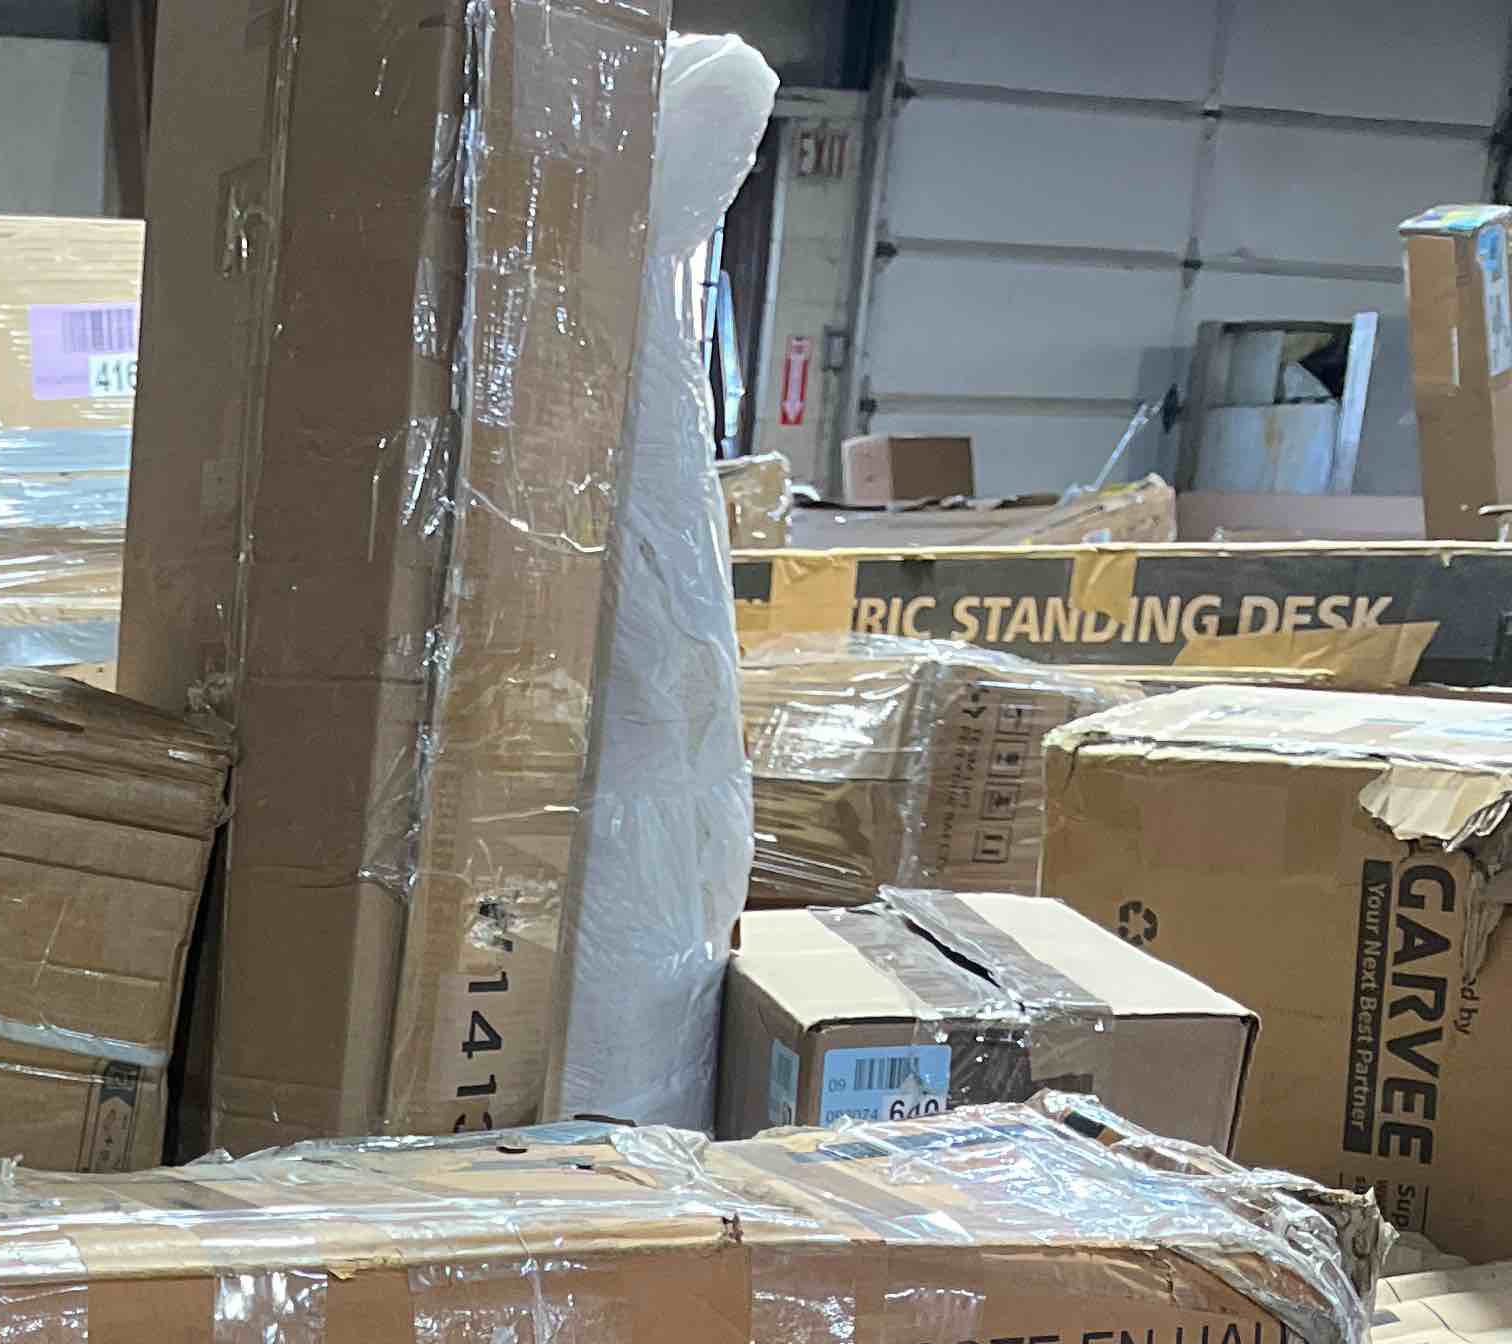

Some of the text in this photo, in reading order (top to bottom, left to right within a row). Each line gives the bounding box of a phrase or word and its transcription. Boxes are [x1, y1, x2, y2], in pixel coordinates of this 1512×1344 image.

[799, 132, 846, 178] EXIT
[951, 595, 1222, 642] STANDING
[1351, 882, 1386, 1131] Your Next Best Partner
[1377, 863, 1456, 1165] GARVEE
